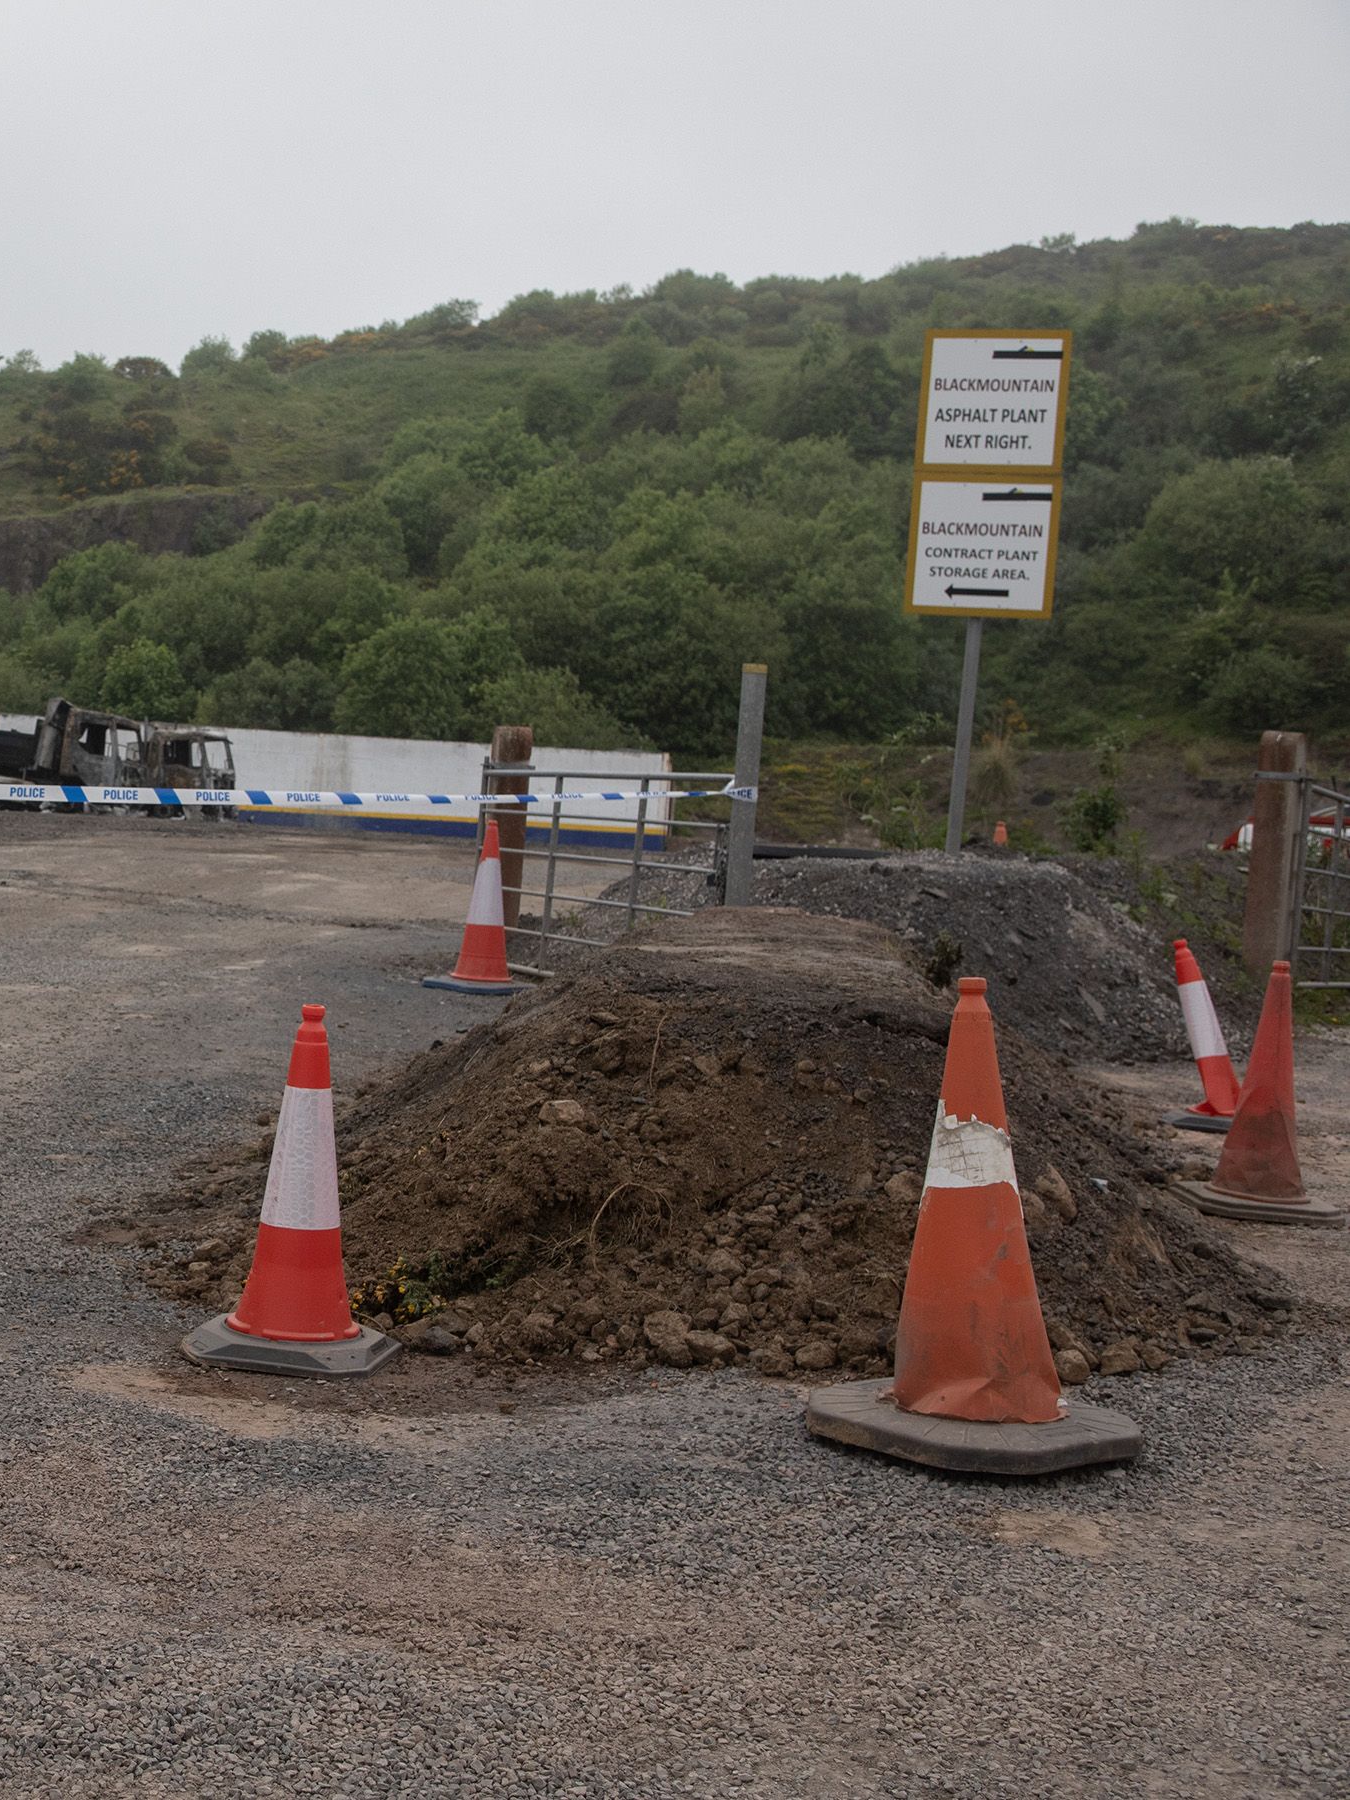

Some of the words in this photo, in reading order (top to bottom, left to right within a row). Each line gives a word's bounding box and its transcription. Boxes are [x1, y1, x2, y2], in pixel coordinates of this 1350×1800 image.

[934, 378, 1055, 393] BLACKMOUNTAIN
[935, 408, 998, 423] ASPHALT
[1001, 409, 1047, 423] PLANT
[945, 434, 981, 449] NEXT
[985, 435, 1032, 450] RIGHT.
[922, 521, 1043, 538] BLACKMOUNTAIN
[925, 547, 993, 560] CONTRACT
[997, 549, 1039, 562] PLANT
[929, 566, 988, 579] STORAGE
[992, 568, 1030, 580] AREA.
[10, 787, 45, 799] POLICE
[103, 790, 139, 801] POLICE
[196, 791, 230, 802] POLICE
[287, 793, 321, 802] POLICE
